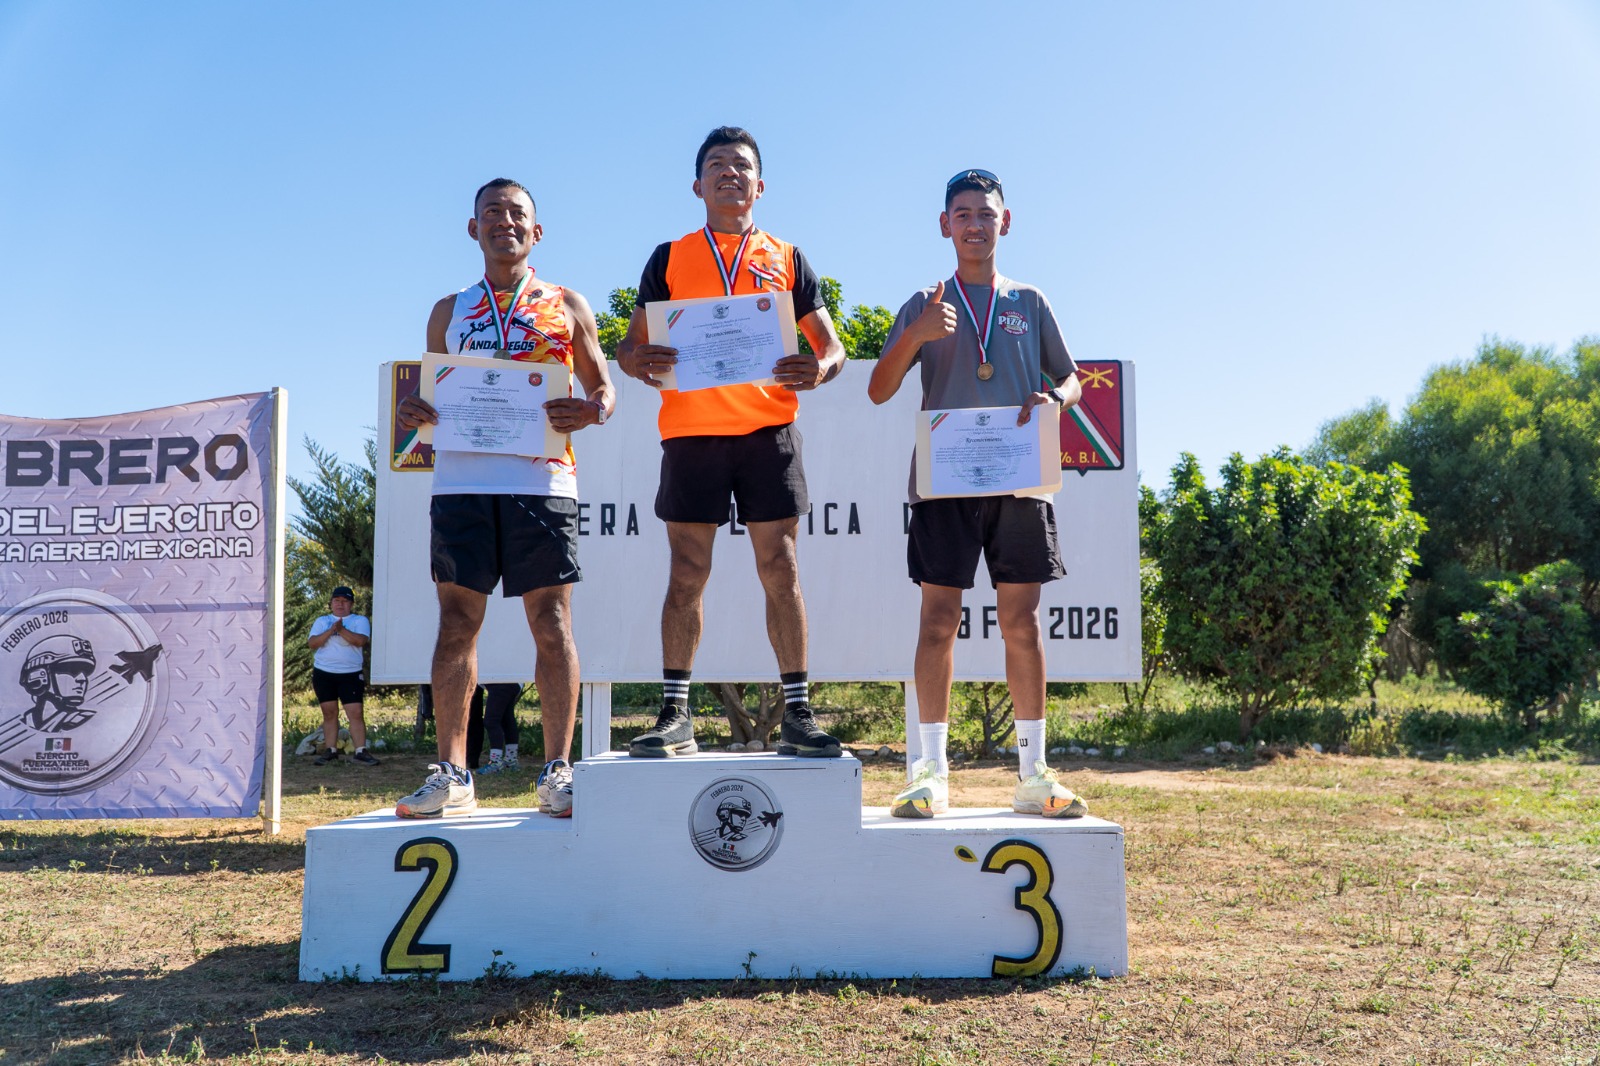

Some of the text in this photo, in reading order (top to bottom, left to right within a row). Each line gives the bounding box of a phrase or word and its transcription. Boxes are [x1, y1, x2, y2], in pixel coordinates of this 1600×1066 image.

[998, 315, 1028, 331] PIZZA
[469, 340, 535, 352] ANDAEGOS
[0, 433, 249, 487] BRERO
[394, 453, 425, 465] ZONA
[71, 501, 260, 536] EJERCITO
[577, 503, 640, 536] ERA
[28, 540, 120, 562] AEREA
[122, 537, 253, 560] MEXICANA
[0, 610, 69, 653] FEBRERO 2026
[1048, 606, 1119, 640] 2026
[710, 786, 731, 800] FEBRERO
[381, 836, 459, 975] 2
[980, 839, 1064, 978] 3
